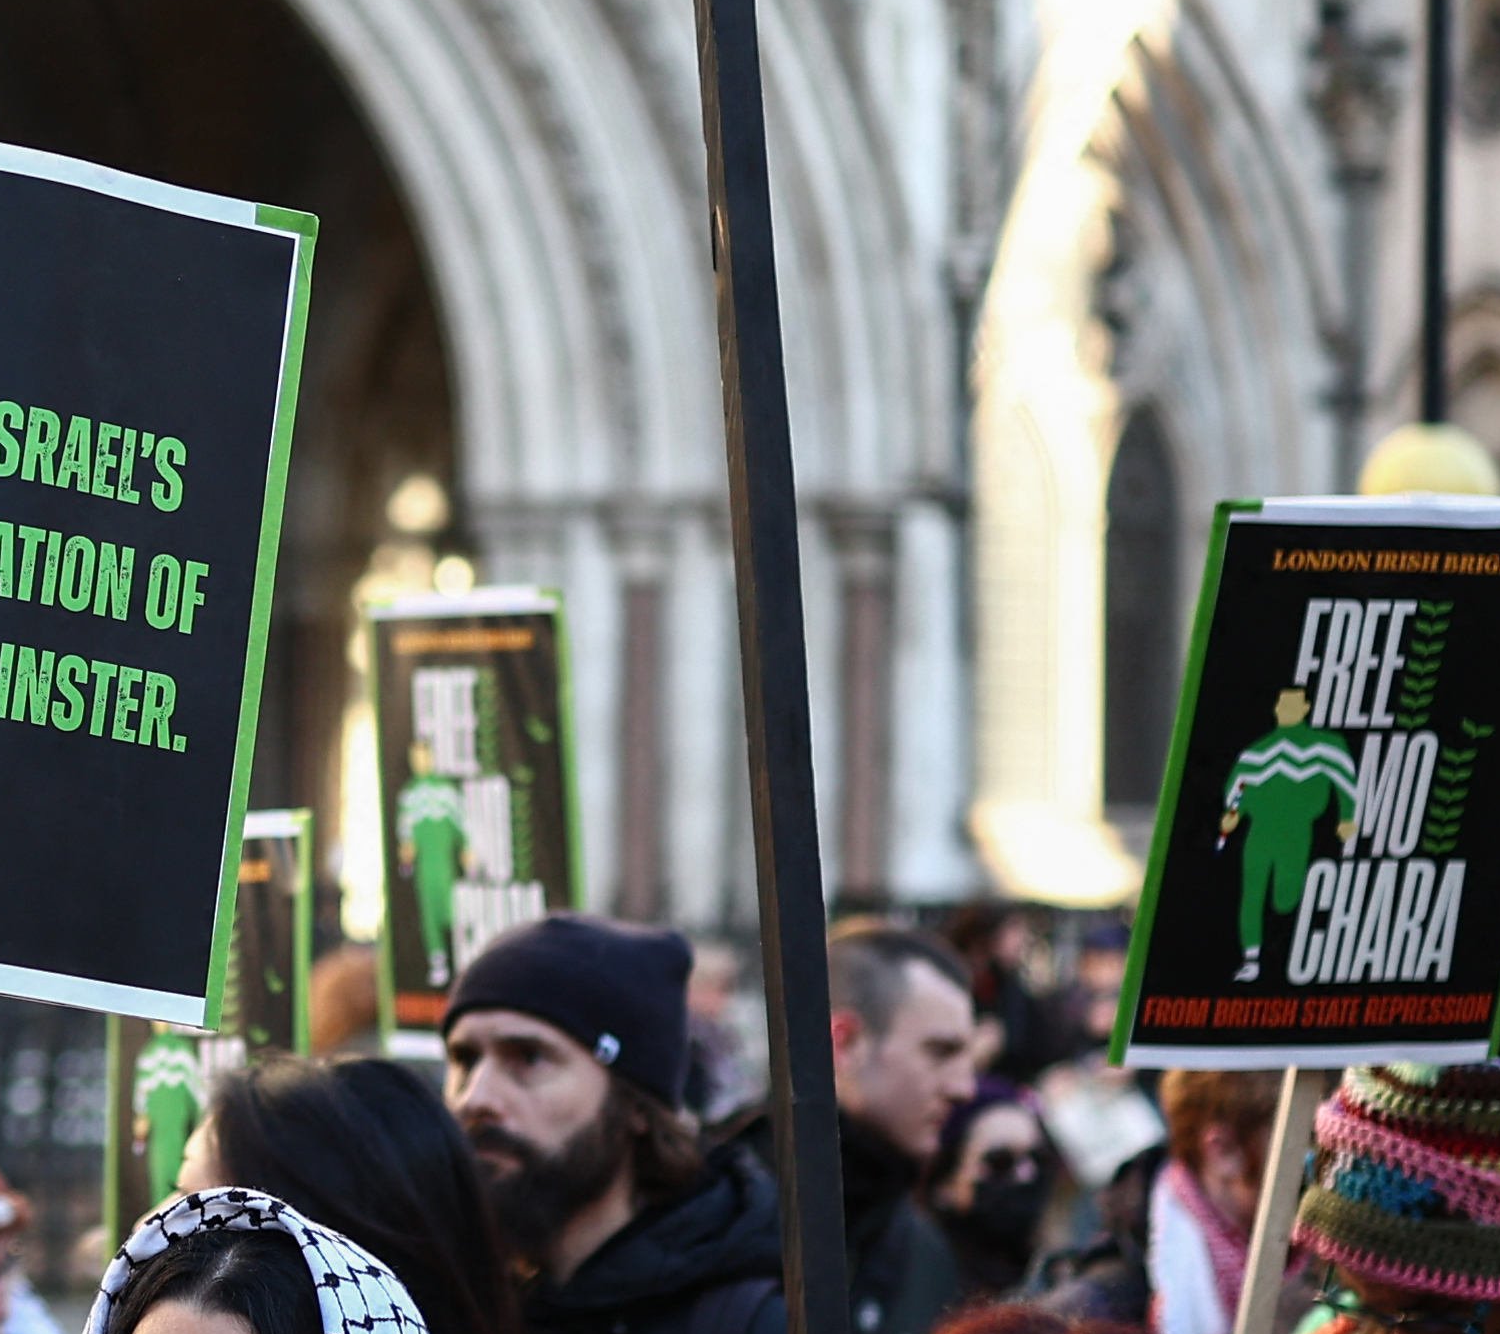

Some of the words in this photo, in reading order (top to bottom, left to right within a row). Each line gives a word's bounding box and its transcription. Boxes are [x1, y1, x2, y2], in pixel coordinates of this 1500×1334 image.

[144, 554, 210, 635] OF
[1271, 549, 1373, 572] LONDON
[1374, 551, 1442, 573] IRISH
[1294, 599, 1417, 728] FREE
[1343, 731, 1439, 859] MO
[1286, 860, 1467, 985] CHARA
[1142, 995, 1211, 1028] FROM
[1212, 995, 1298, 1028] BRITISH
[1300, 994, 1362, 1027] STATE
[1363, 992, 1493, 1026] REPRESSION
